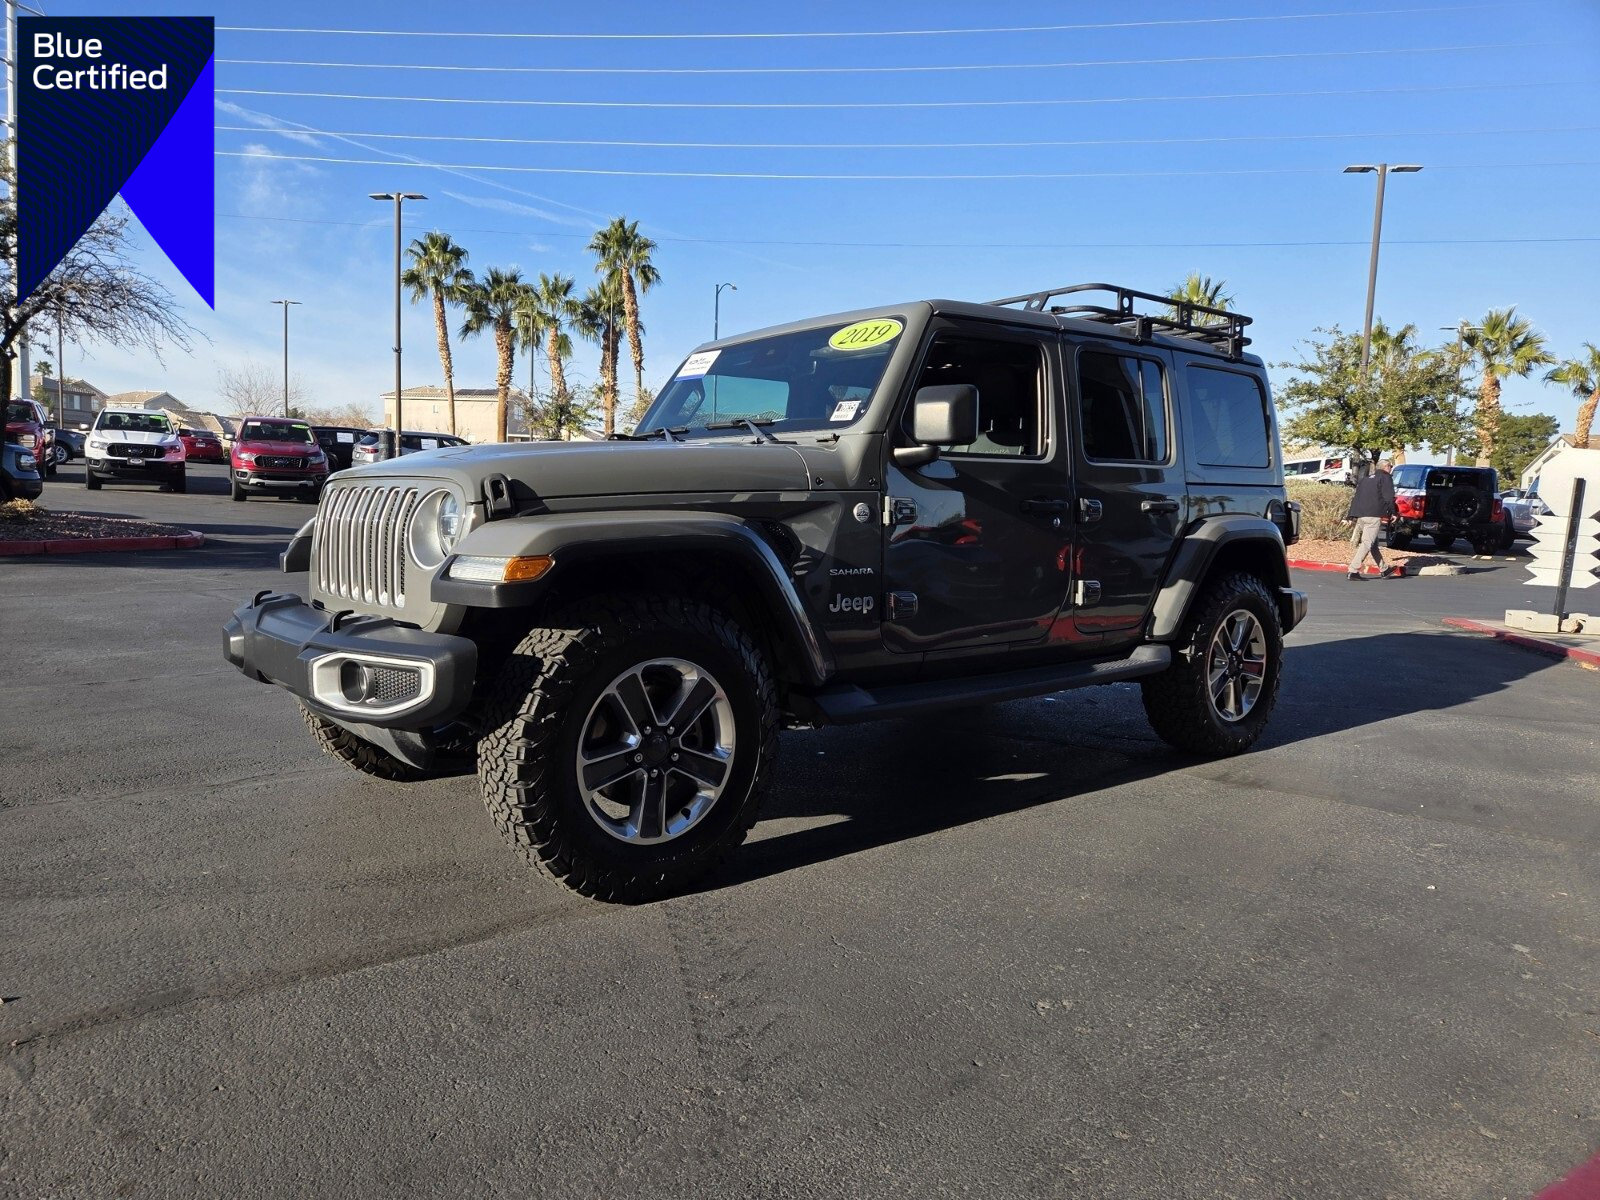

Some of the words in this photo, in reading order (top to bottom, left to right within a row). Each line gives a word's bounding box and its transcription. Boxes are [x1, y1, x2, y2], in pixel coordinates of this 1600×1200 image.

[837, 324, 892, 345] 2019
[829, 567, 874, 576] SAHARA
[829, 593, 875, 614] Jeep
